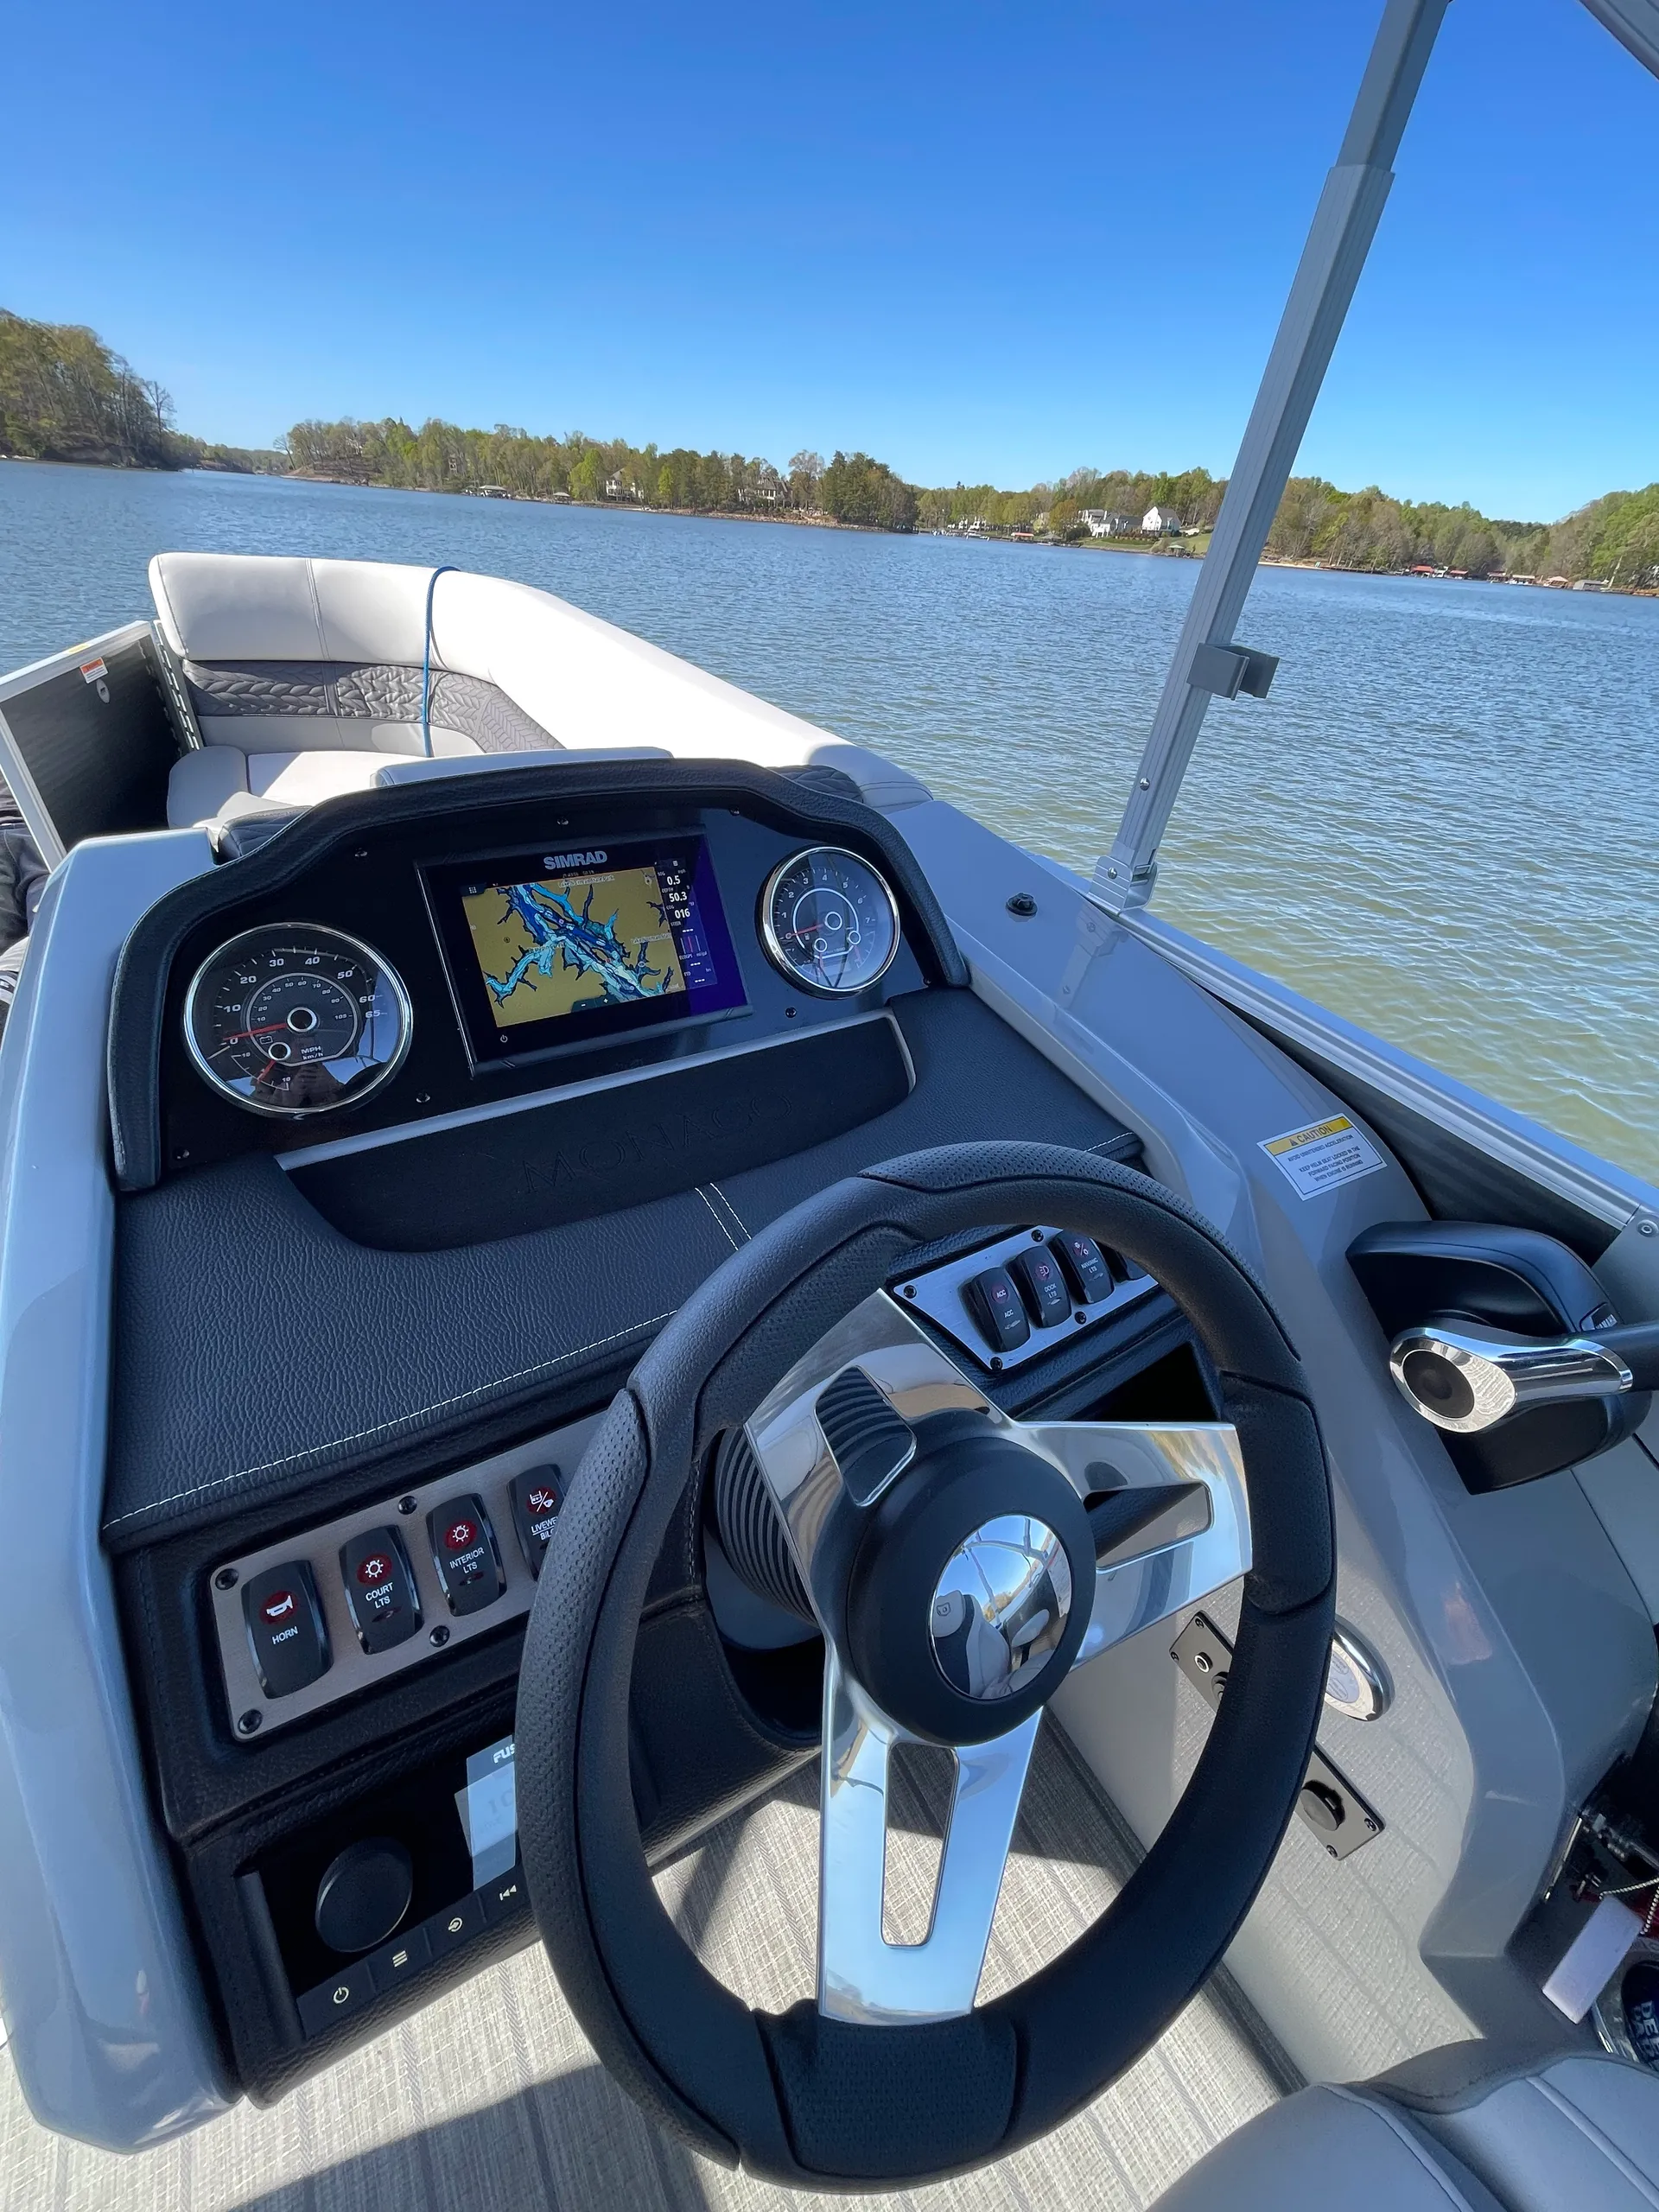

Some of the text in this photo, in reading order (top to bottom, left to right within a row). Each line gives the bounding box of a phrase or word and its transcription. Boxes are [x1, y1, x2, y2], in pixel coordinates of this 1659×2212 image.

[543, 850, 607, 870] SIMRAD
[666, 874, 681, 886] 0.5
[669, 891, 688, 902] 50.3
[674, 907, 690, 919] 016
[269, 957, 284, 968] 30
[305, 956, 320, 966] 40
[239, 975, 257, 985] 20
[337, 969, 353, 980] 50
[359, 994, 376, 1003] 60
[224, 1003, 241, 1014] 10
[365, 1009, 381, 1019] 65
[229, 1037, 238, 1046] 0
[301, 1046, 321, 1054] MPH
[302, 1052, 323, 1061] km/h
[1296, 1125, 1332, 1143] CAUTION
[521, 1092, 792, 1193] MONACO
[996, 1289, 1007, 1299] ACC
[1044, 1282, 1058, 1294] DOCK
[1004, 1309, 1014, 1318] ACC
[531, 1516, 559, 1534] LIVEWE
[539, 1528, 555, 1541] BIL
[448, 1546, 485, 1570] INTERIOR
[462, 1560, 478, 1574] LTS
[365, 1581, 394, 1602] COURT
[374, 1595, 391, 1610] LTS
[270, 1625, 299, 1645] HORN
[493, 1743, 515, 1764] FUS
